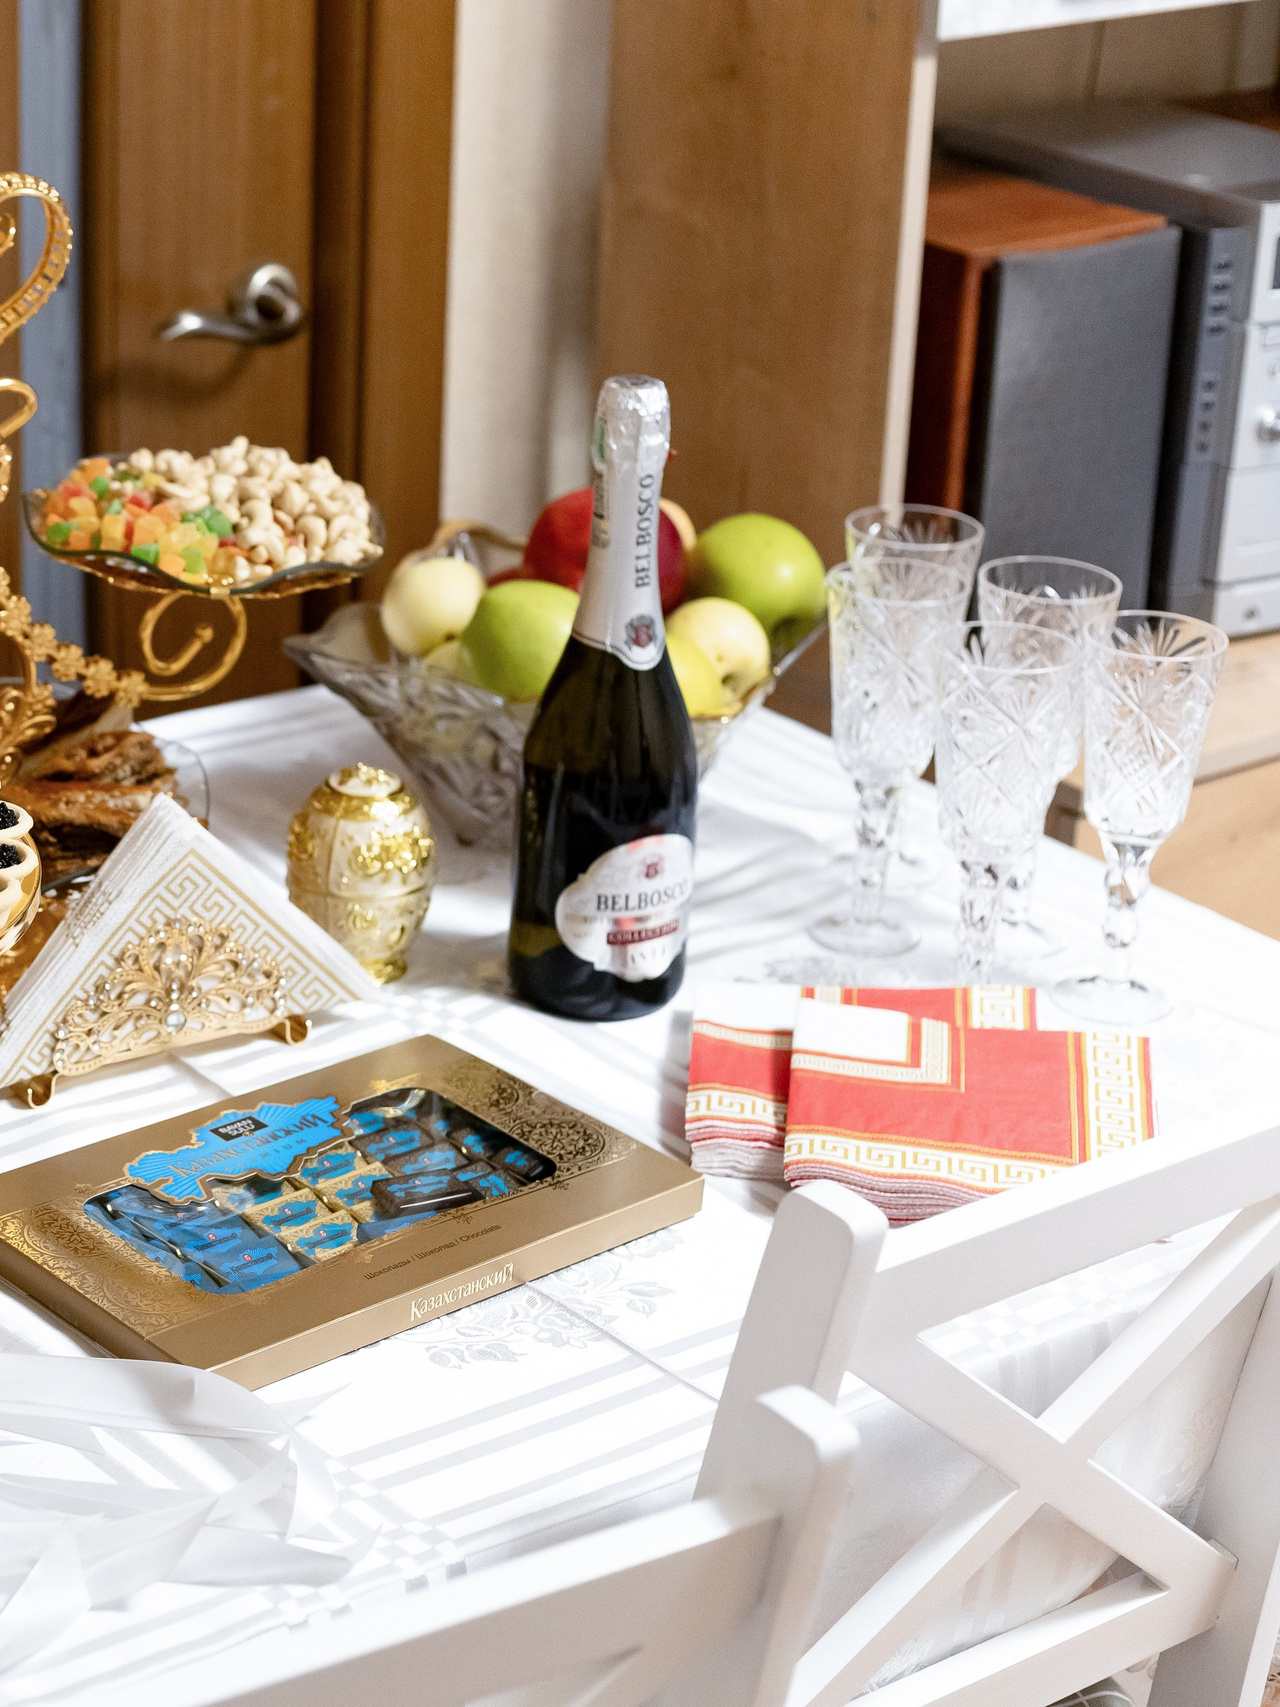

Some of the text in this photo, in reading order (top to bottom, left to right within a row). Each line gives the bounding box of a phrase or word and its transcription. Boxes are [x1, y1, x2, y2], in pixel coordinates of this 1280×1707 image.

[634, 473, 655, 588] BELBOSCO
[596, 878, 688, 912] BELBOSCO
[167, 1113, 329, 1178] Казахстанский
[228, 1123, 255, 1136] SULU
[363, 1258, 411, 1281] Шоколады
[415, 1241, 456, 1260] Шоколад
[459, 1223, 502, 1243] Chocolate
[410, 1262, 515, 1322] Казахстанский
